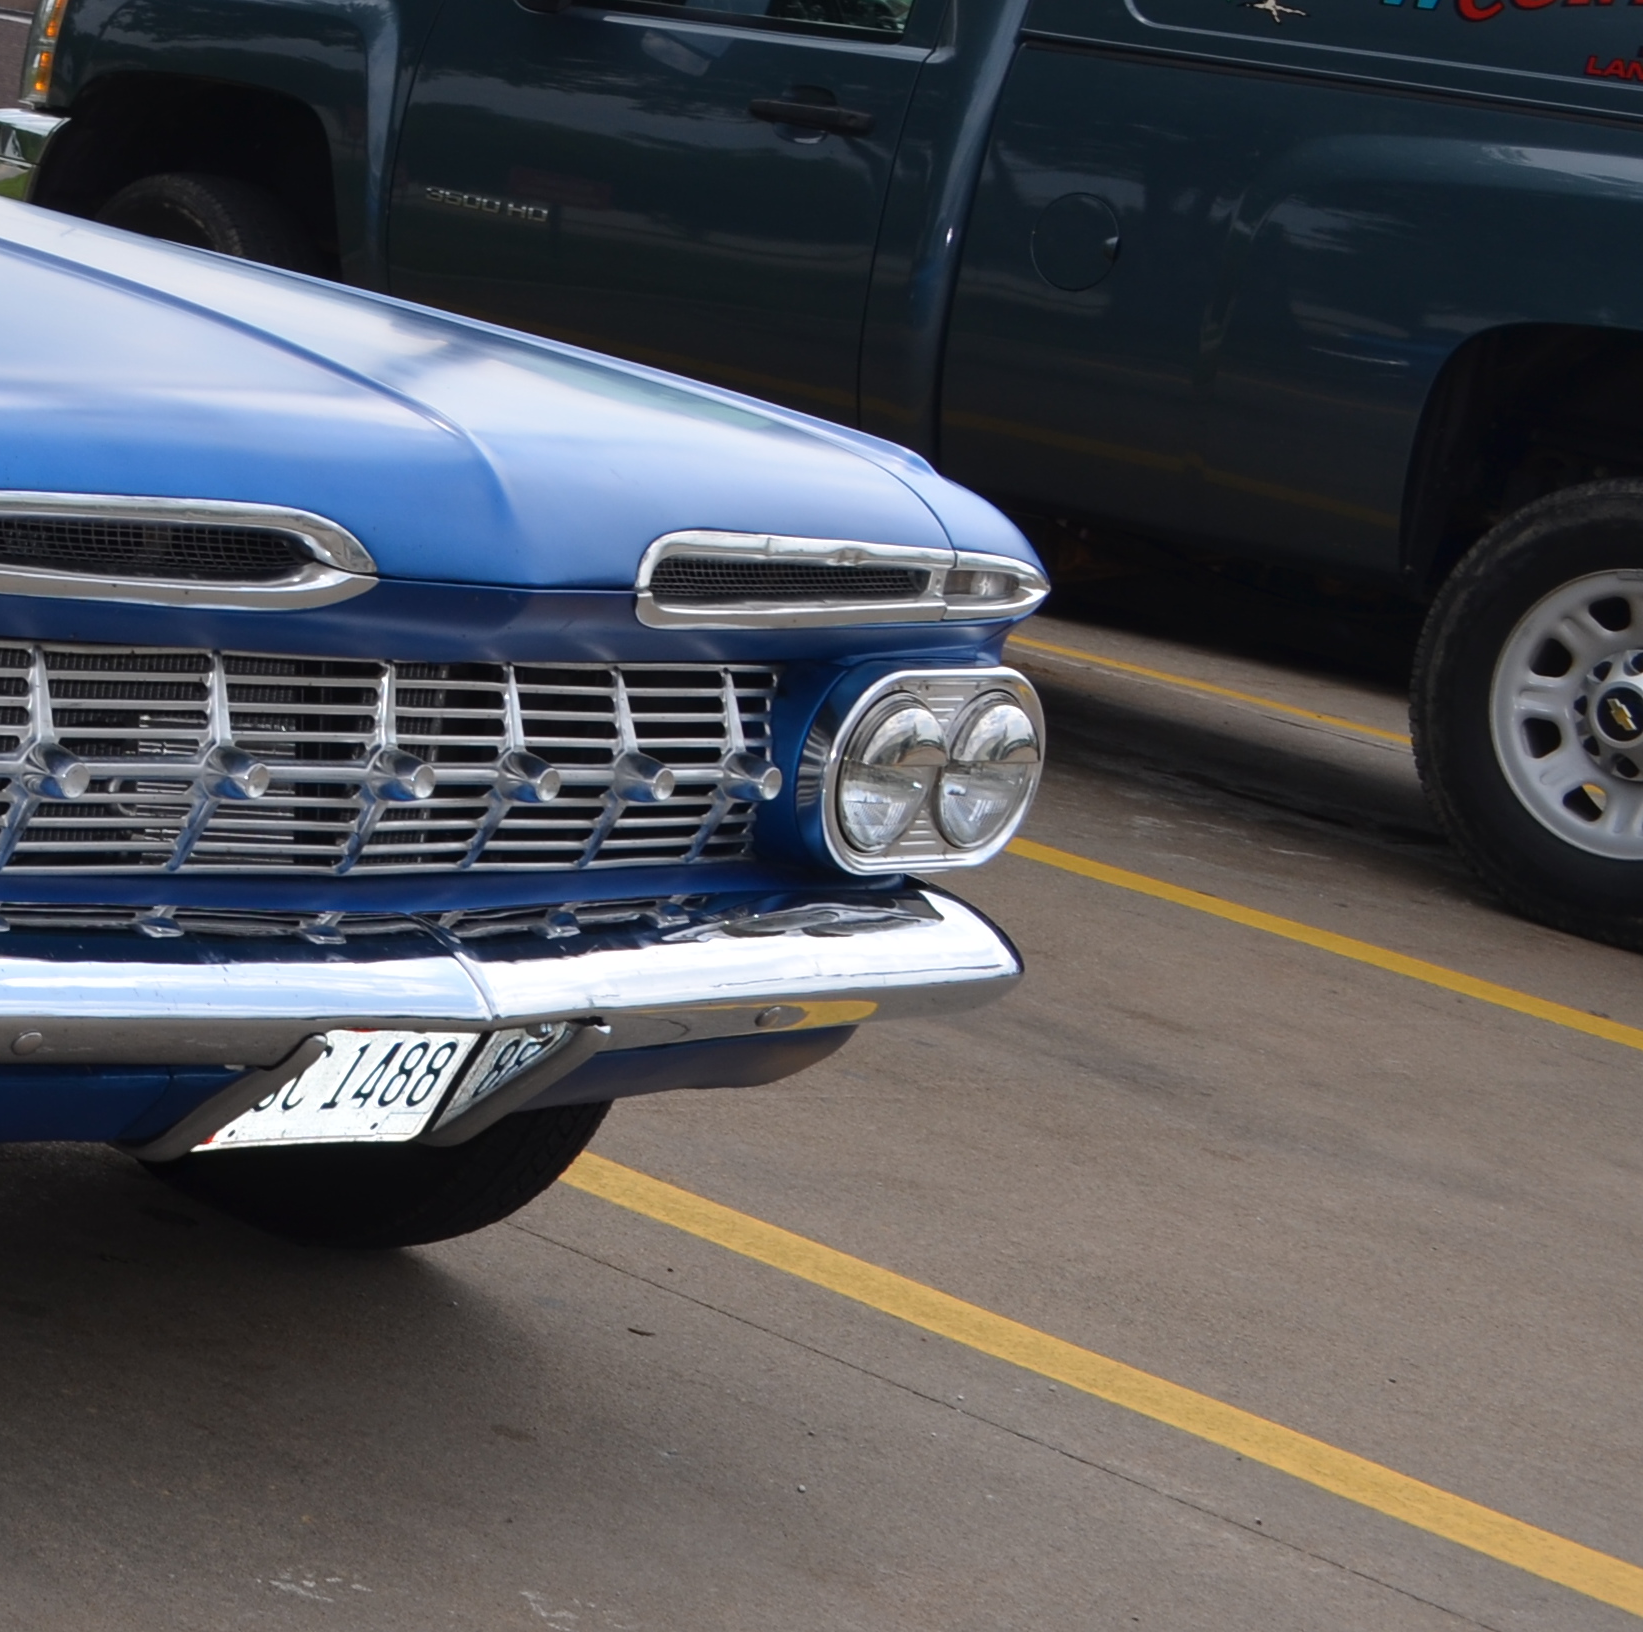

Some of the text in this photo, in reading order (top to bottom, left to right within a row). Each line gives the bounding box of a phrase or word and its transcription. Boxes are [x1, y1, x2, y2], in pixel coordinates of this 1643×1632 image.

[426, 187, 548, 222] 3500 HD
[320, 1041, 459, 1109] 1488
